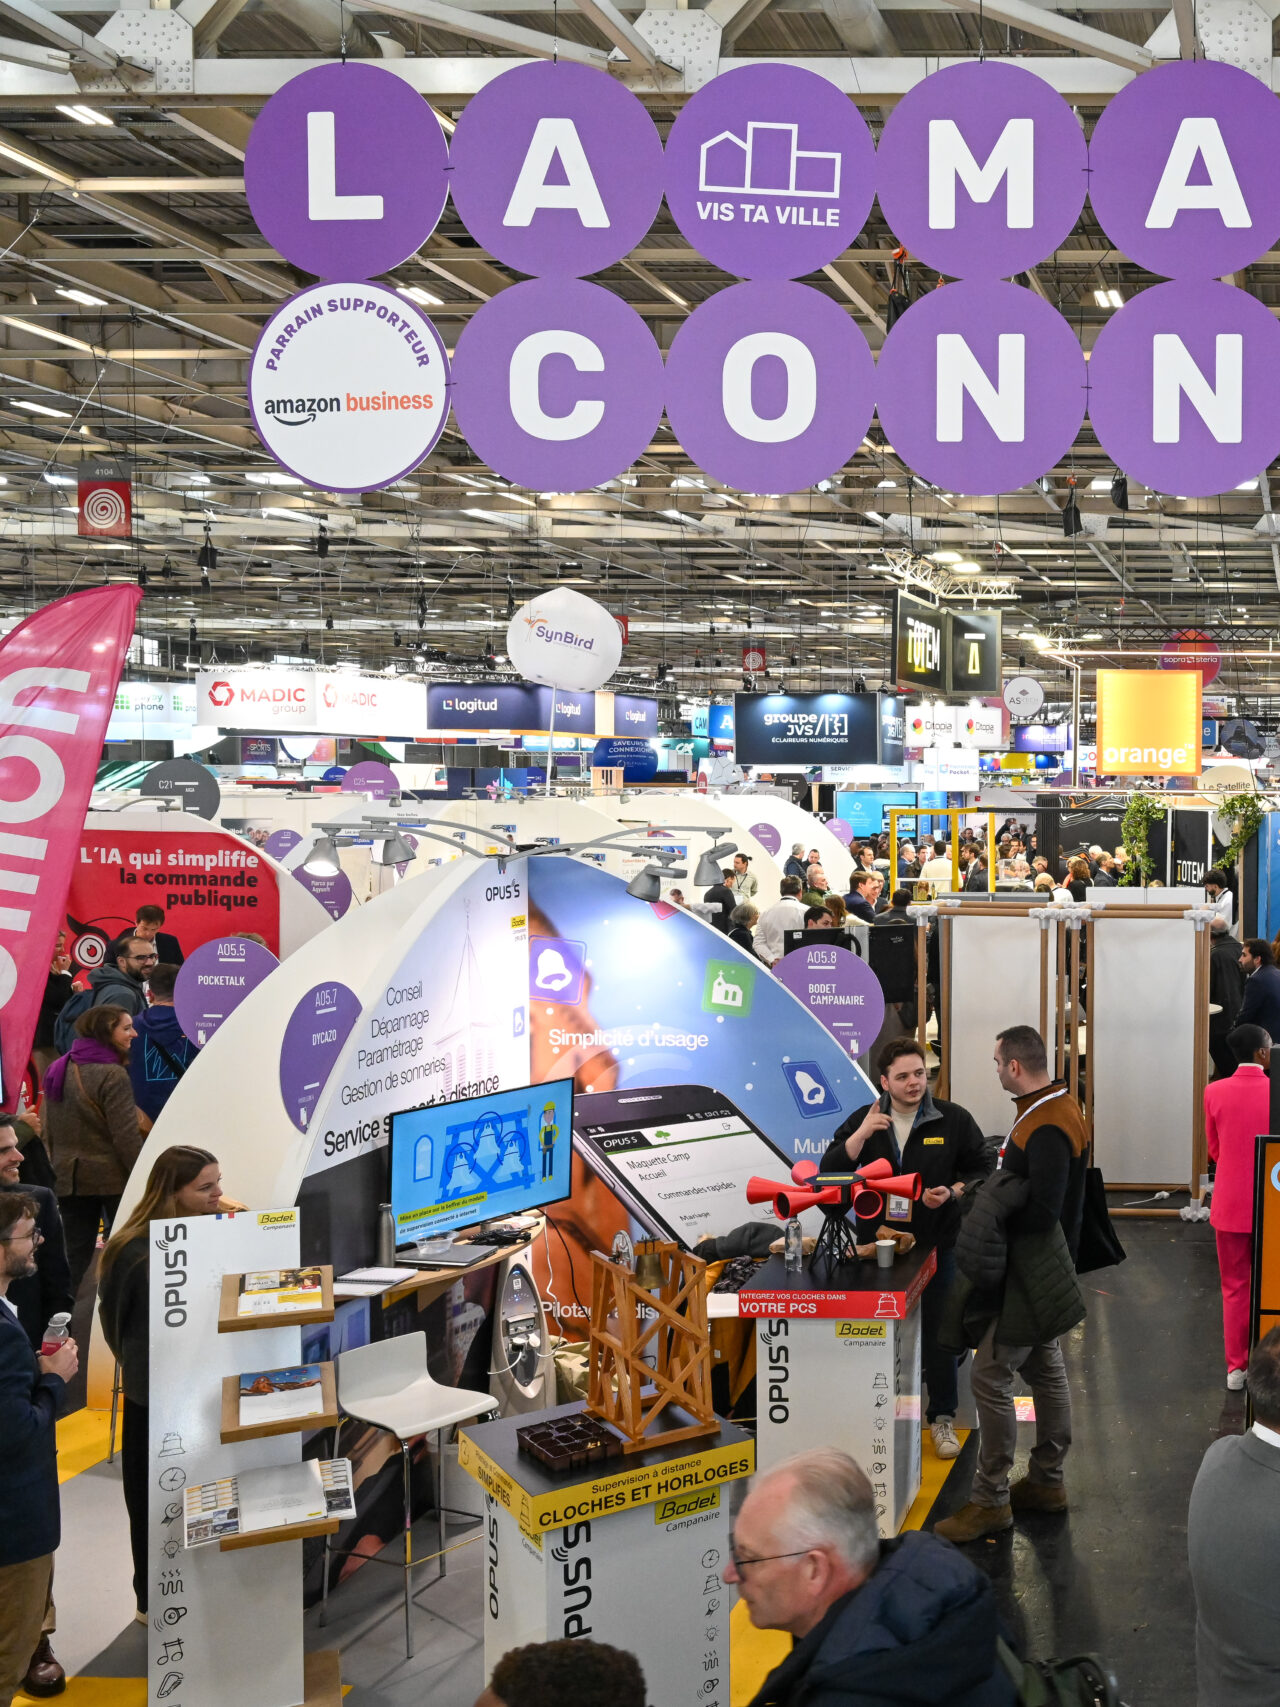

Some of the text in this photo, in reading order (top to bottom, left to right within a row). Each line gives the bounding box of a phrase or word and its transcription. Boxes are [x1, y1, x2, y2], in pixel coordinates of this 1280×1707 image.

[696, 201, 840, 227] VIS TA VILLE
[264, 296, 431, 372] PARRAIN SUPPORTEUR
[264, 391, 433, 415] amazon business
[536, 625, 594, 650] SynBird
[1164, 655, 1218, 664] sopra steria
[240, 688, 306, 702] MADIC
[134, 703, 164, 711] phone
[272, 704, 306, 714] group
[455, 698, 646, 723] logitud logitud logitud
[764, 713, 818, 726] groupe
[786, 725, 814, 736] JVS
[1103, 747, 1187, 768] orange
[158, 780, 173, 789] C21
[353, 777, 365, 786] C25
[80, 847, 259, 871] L'IA qui simplifie
[119, 867, 259, 888] la commande
[1176, 860, 1205, 884] TOTEM
[166, 889, 258, 911] publique
[217, 943, 246, 957] A05.5
[807, 950, 837, 964] A05.8
[197, 974, 246, 987] POCKETALK
[808, 983, 837, 994] BODET
[315, 988, 338, 1007] A05.7
[386, 980, 424, 1007] Conseil
[810, 994, 865, 1006] CAMPANAIRE
[371, 1008, 430, 1039] Dépannage
[312, 1028, 337, 1046] DYCAZO
[548, 1028, 709, 1050] Simplicité d'usage
[358, 1033, 424, 1070] Paramétrage
[341, 1055, 447, 1106] Gestion de sonneries
[324, 1074, 500, 1158] Service distance
[603, 1135, 638, 1148] OPUS S
[626, 1150, 691, 1170] Maquette Camp
[638, 1169, 667, 1181] Accueil
[657, 1180, 736, 1201] Commandes rapides
[260, 1213, 294, 1224] Bodet
[679, 1210, 711, 1223] Mariage
[740, 1292, 775, 1300] INTEGREZ
[826, 1293, 847, 1301] DANS
[740, 1302, 817, 1314] VOTRE PCS
[838, 1323, 884, 1336] Bodet
[843, 1339, 886, 1347] Campanaire
[591, 1457, 702, 1495] Supervision à distance
[477, 1465, 511, 1508] SIMPLIFIES
[538, 1458, 750, 1527] CLOCHES ET HORLOGES
[659, 1491, 718, 1521] Bodet
[665, 1510, 721, 1533] Campanaire
